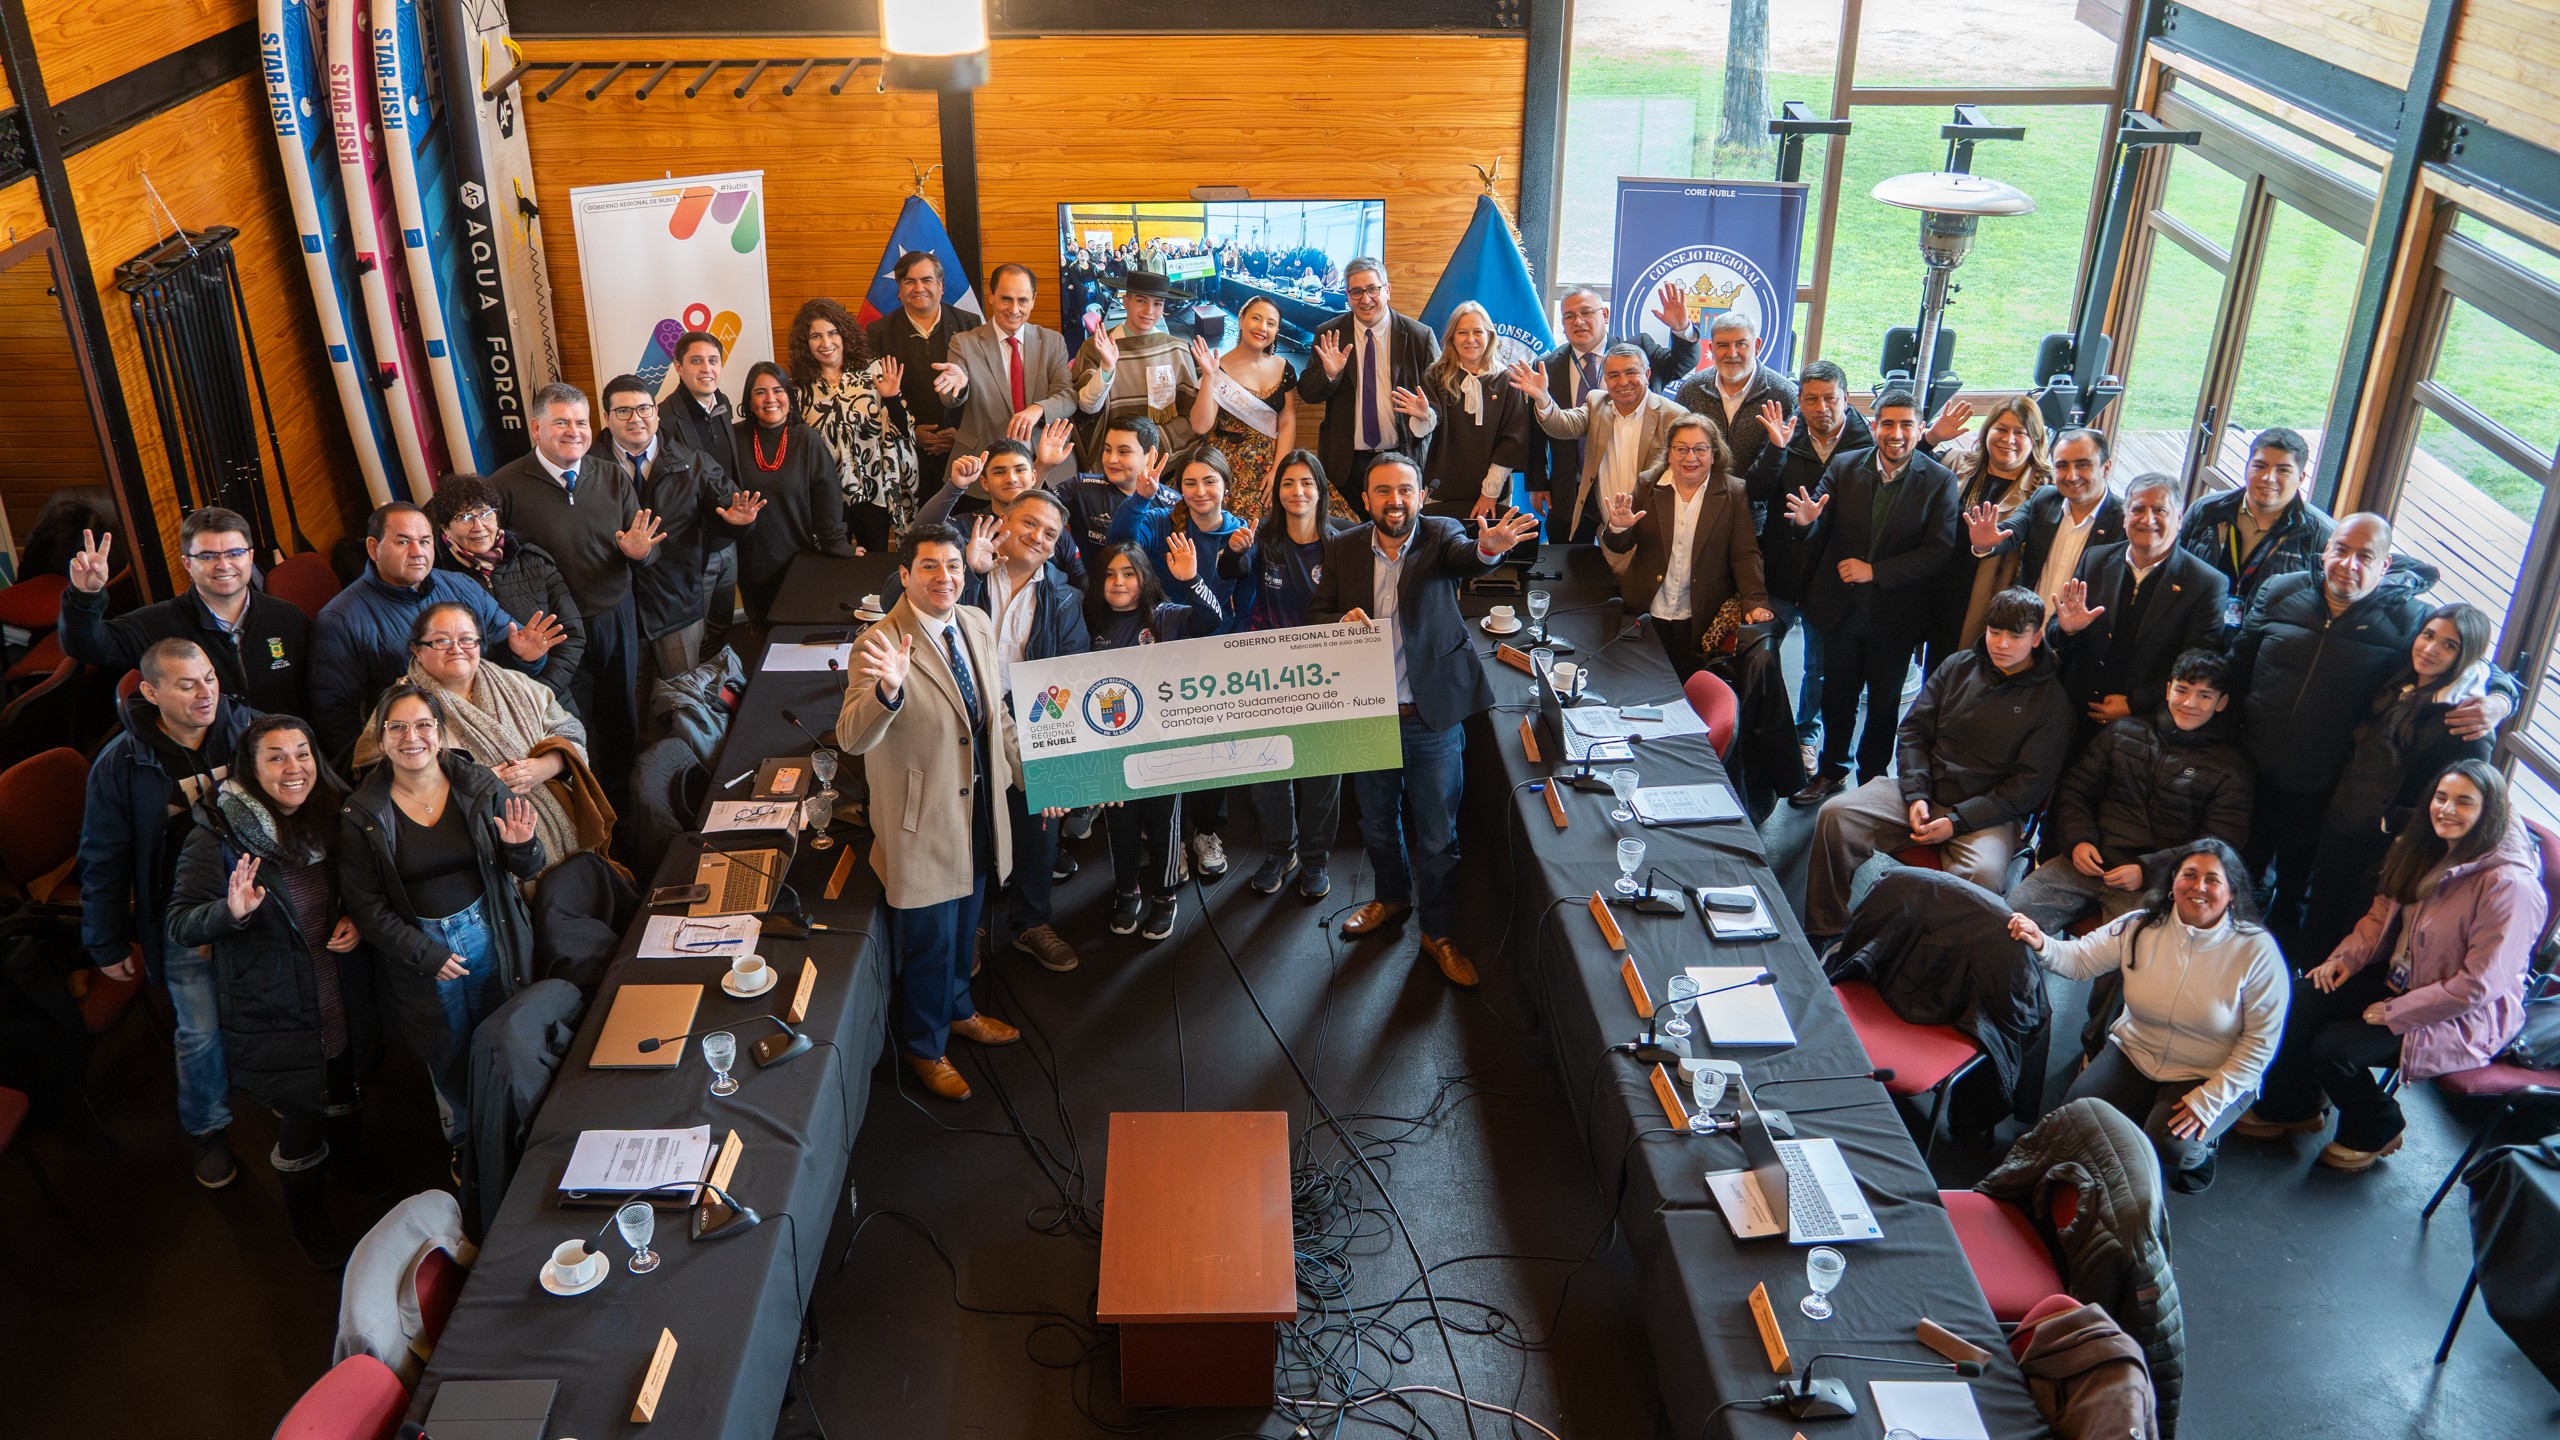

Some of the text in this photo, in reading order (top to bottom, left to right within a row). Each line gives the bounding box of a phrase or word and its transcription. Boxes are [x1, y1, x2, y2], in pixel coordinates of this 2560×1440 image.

[261, 32, 296, 137] STAR-FISH
[374, 28, 404, 130] STAR-FISH
[330, 63, 360, 165] STAR-FISH
[587, 202, 619, 211] GOBIERNO
[619, 200, 649, 208] REGIONAL
[1684, 187, 1737, 198] CORE ÑUBLE
[1649, 249, 1761, 288] CONSEJO REGIONAL
[466, 218, 522, 430] AQUA FORCE
[1493, 322, 1544, 351] ONSEJO
[1223, 625, 1381, 649] GOBIERNO REGIONAL DE ÑUBLE
[1290, 641, 1323, 651] Miércoles
[1328, 639, 1338, 647] de
[1339, 638, 1353, 647] julio
[1354, 637, 1364, 645] de
[1157, 662, 1341, 703] $ 59.841.413.-
[1160, 689, 1338, 718] Campeonato Sudamericano de
[1161, 714, 1214, 729] Canotaje
[1216, 713, 1224, 723] y
[1226, 702, 1303, 721] Paracanotaje
[1305, 699, 1345, 712] Quillón
[1352, 695, 1386, 708] Ñuble
[1030, 720, 1075, 733] GOBIERNO
[1031, 729, 1076, 741] REGIONAL
[1032, 735, 1078, 749] DE ÑUBLE
